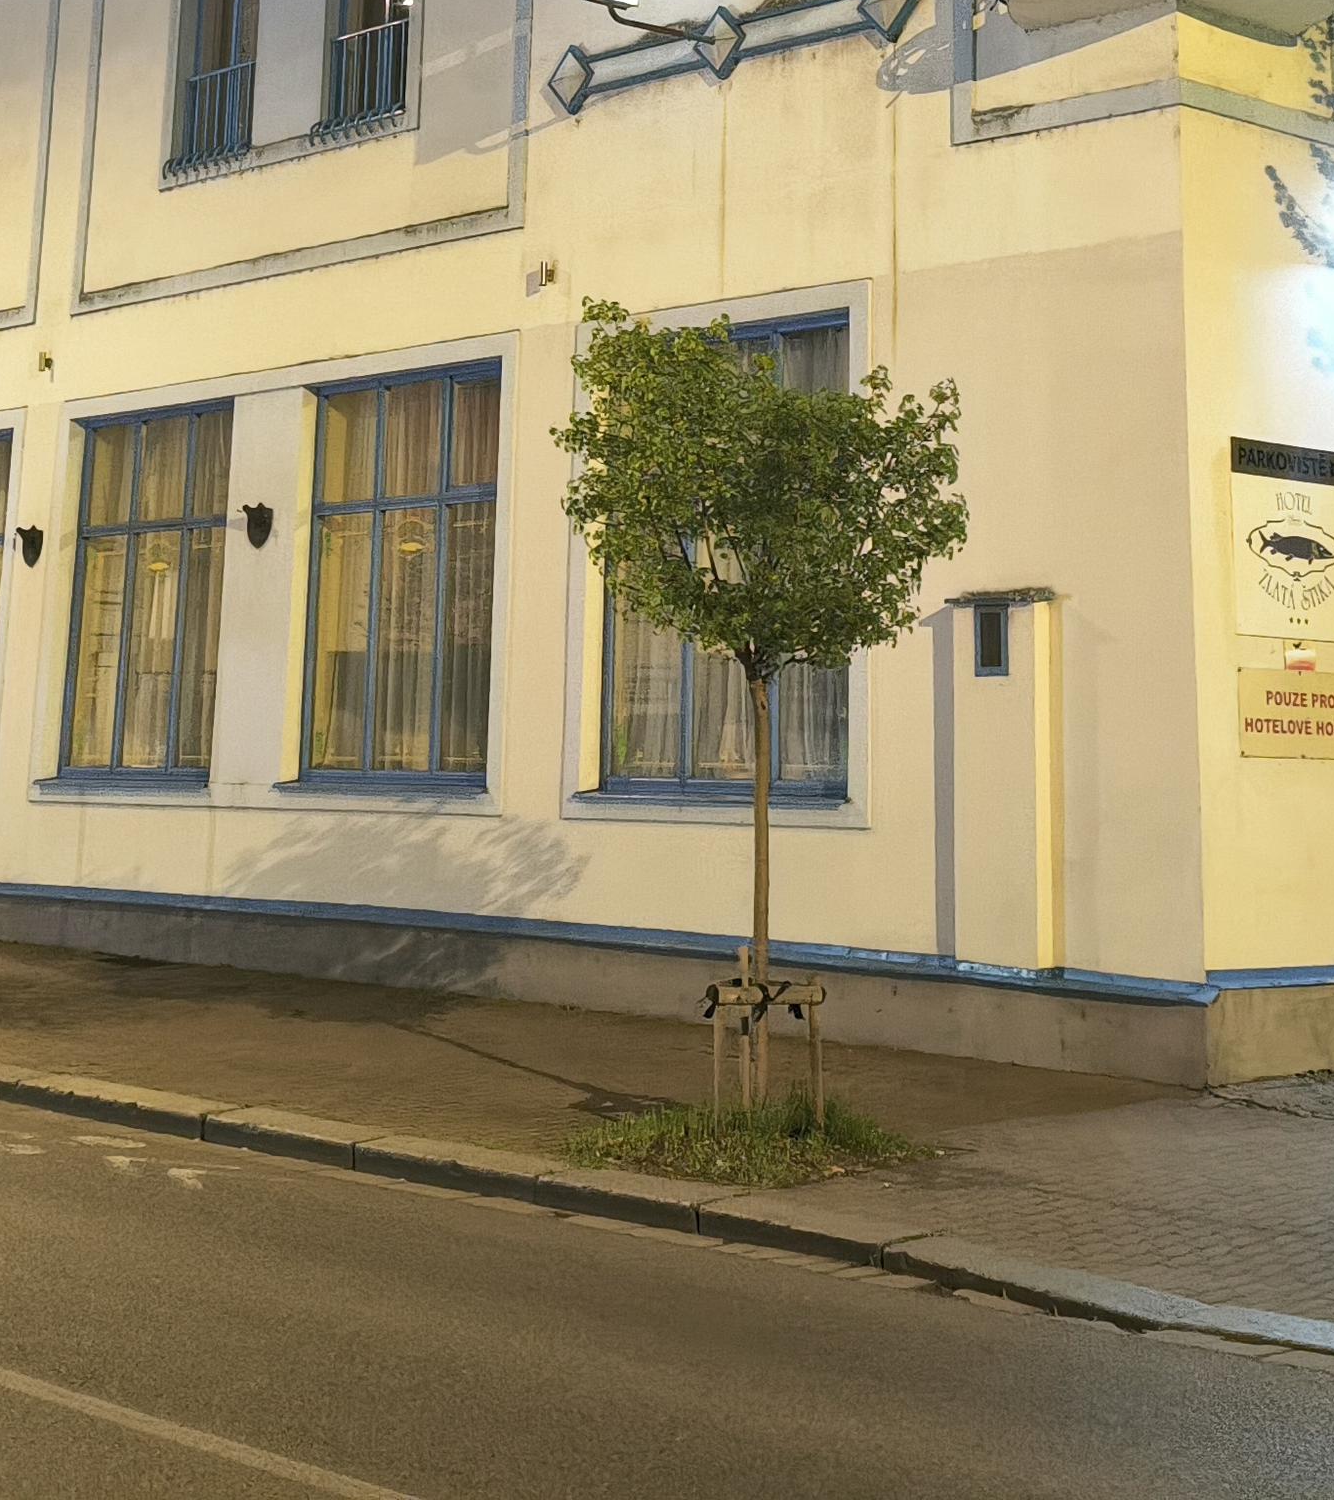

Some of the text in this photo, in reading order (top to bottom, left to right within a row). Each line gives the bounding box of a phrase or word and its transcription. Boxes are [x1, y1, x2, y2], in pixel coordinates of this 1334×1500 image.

[1237, 444, 1327, 477] PARKOVIŠTĚ
[1275, 491, 1313, 515] HOTEL
[1258, 568, 1296, 610] ZLATÁ
[1266, 690, 1308, 708] POUZE
[1244, 716, 1312, 735] HOTELOVÉ
